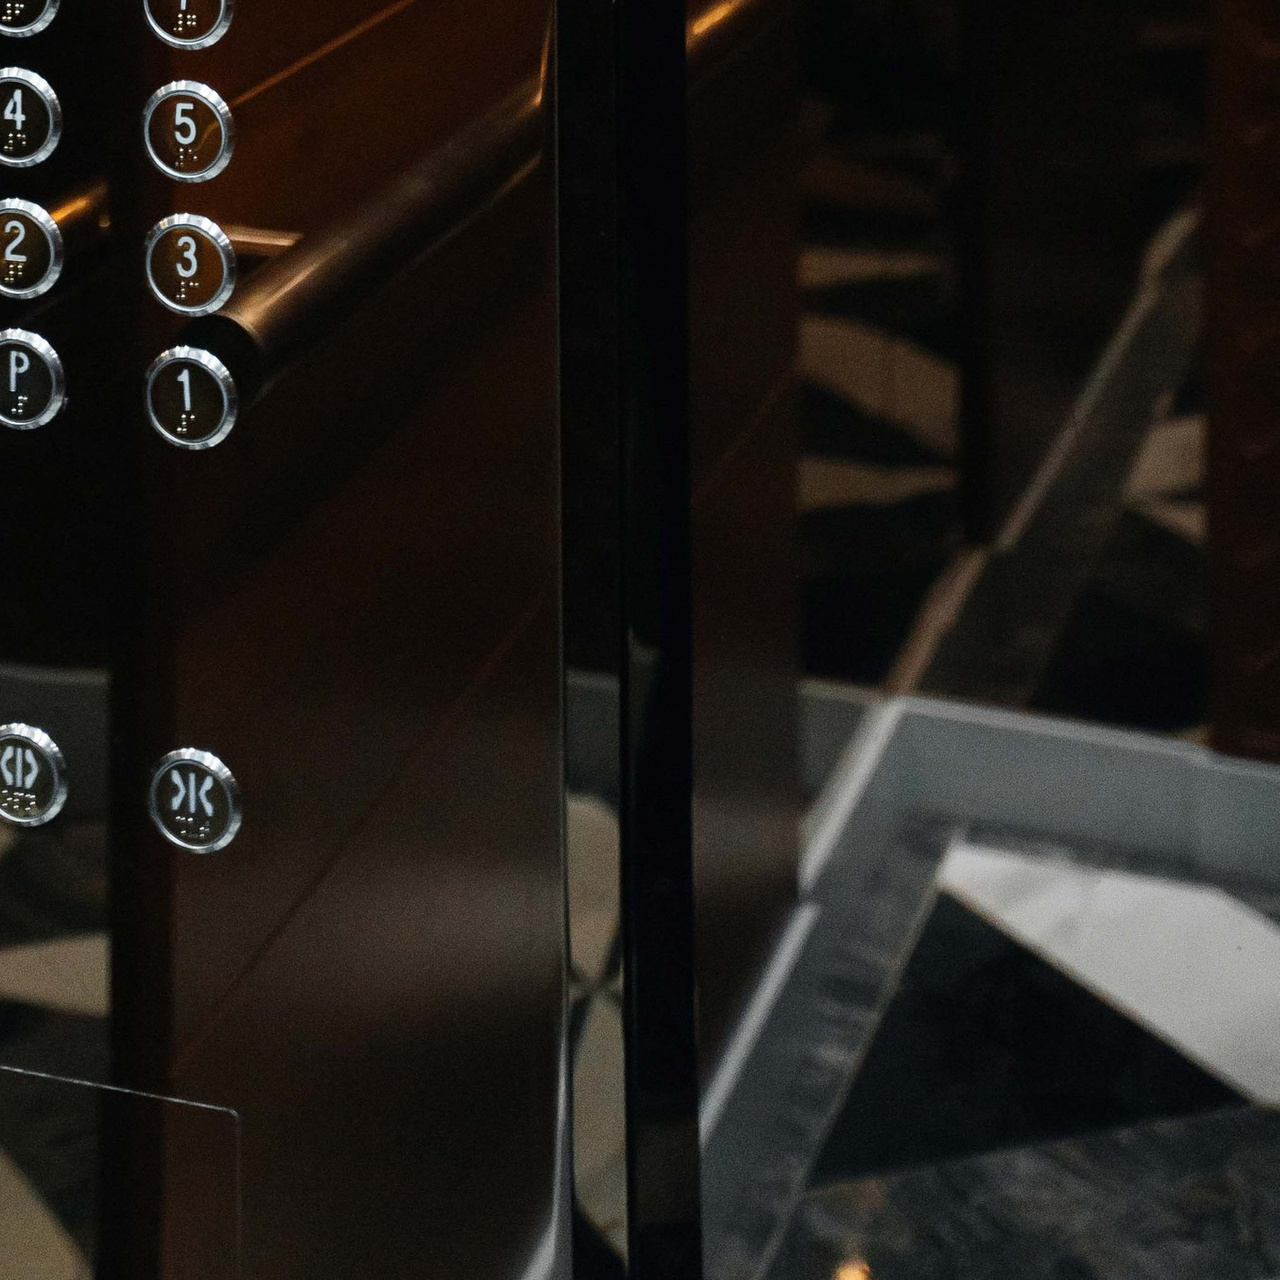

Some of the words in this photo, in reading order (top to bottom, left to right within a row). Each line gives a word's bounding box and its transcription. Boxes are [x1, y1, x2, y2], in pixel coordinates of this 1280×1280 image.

[3, 88, 26, 130] 4
[174, 102, 196, 145] 5
[4, 220, 27, 262] 2
[176, 236, 198, 278] 3
[9, 350, 30, 392] P
[177, 369, 191, 411] 1
